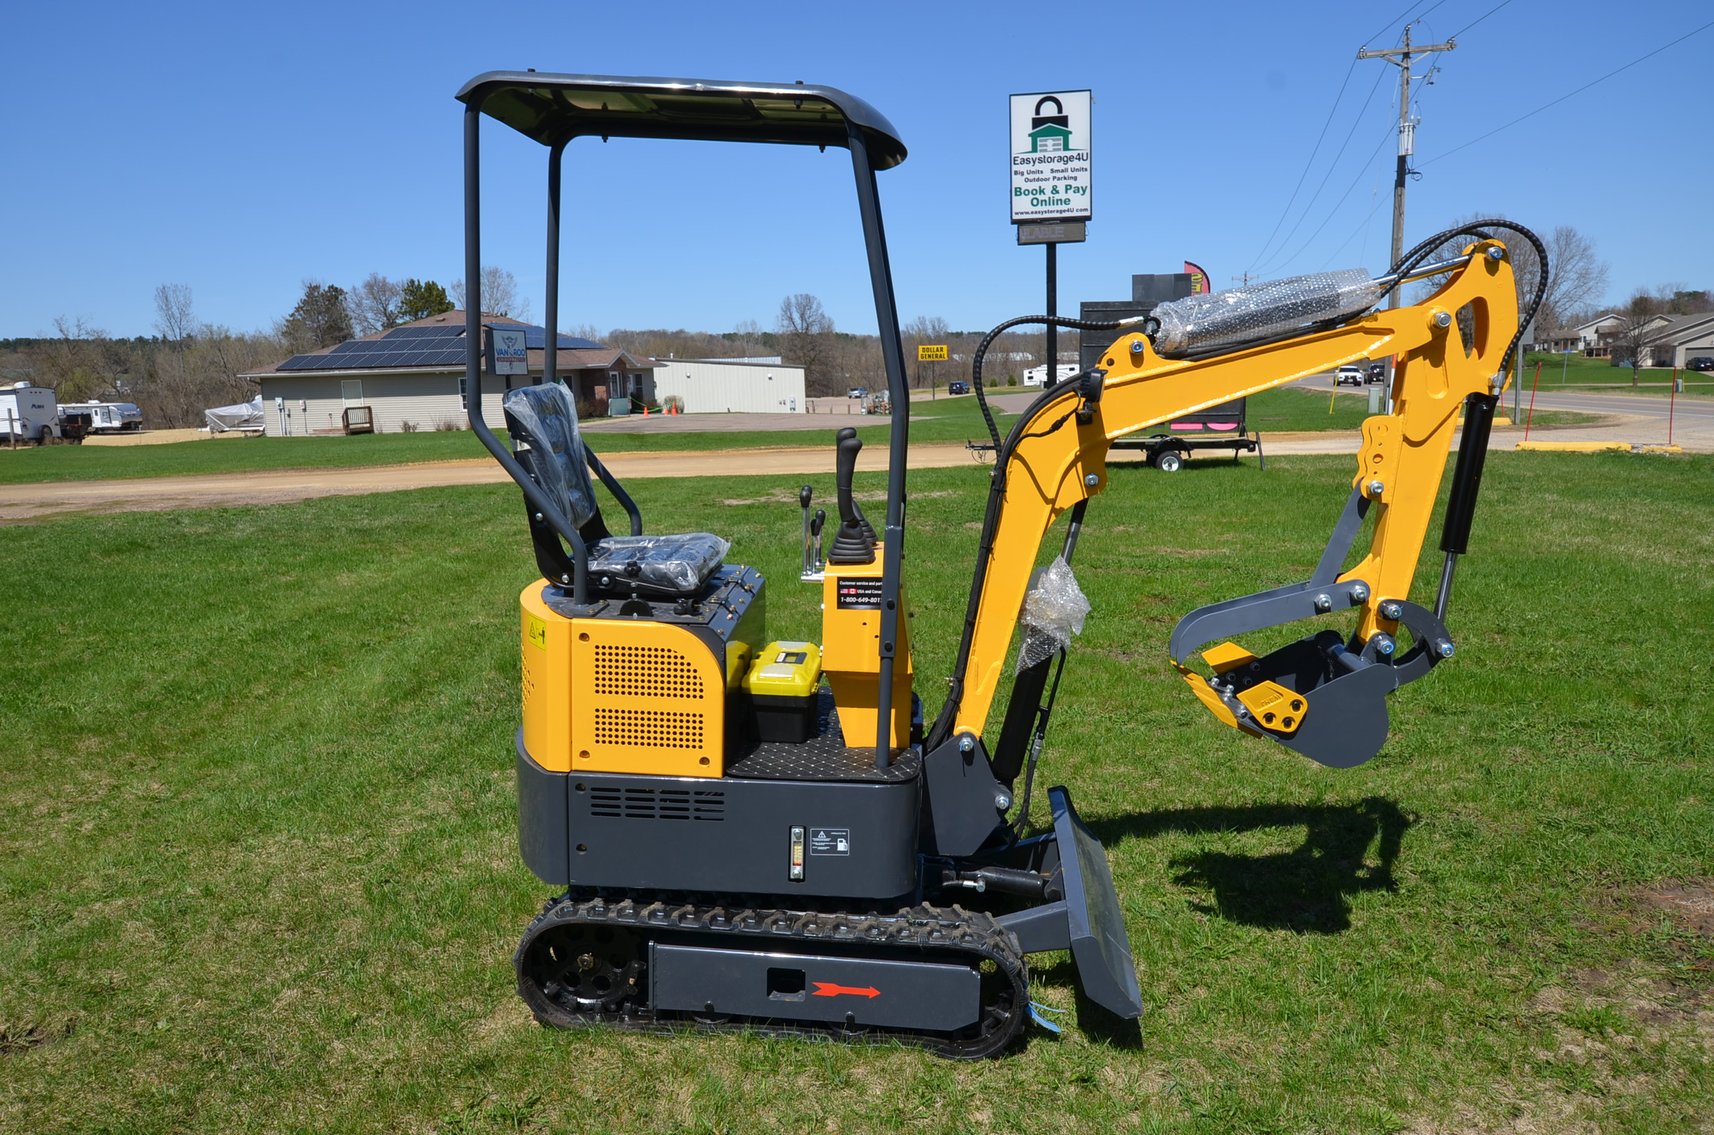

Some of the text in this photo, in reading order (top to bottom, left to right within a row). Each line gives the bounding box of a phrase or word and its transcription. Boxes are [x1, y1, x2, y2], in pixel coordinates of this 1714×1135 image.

[1013, 152, 1088, 167] Easystorage4U
[1014, 184, 1088, 197] Book & Pay
[1030, 196, 1071, 207] Online
